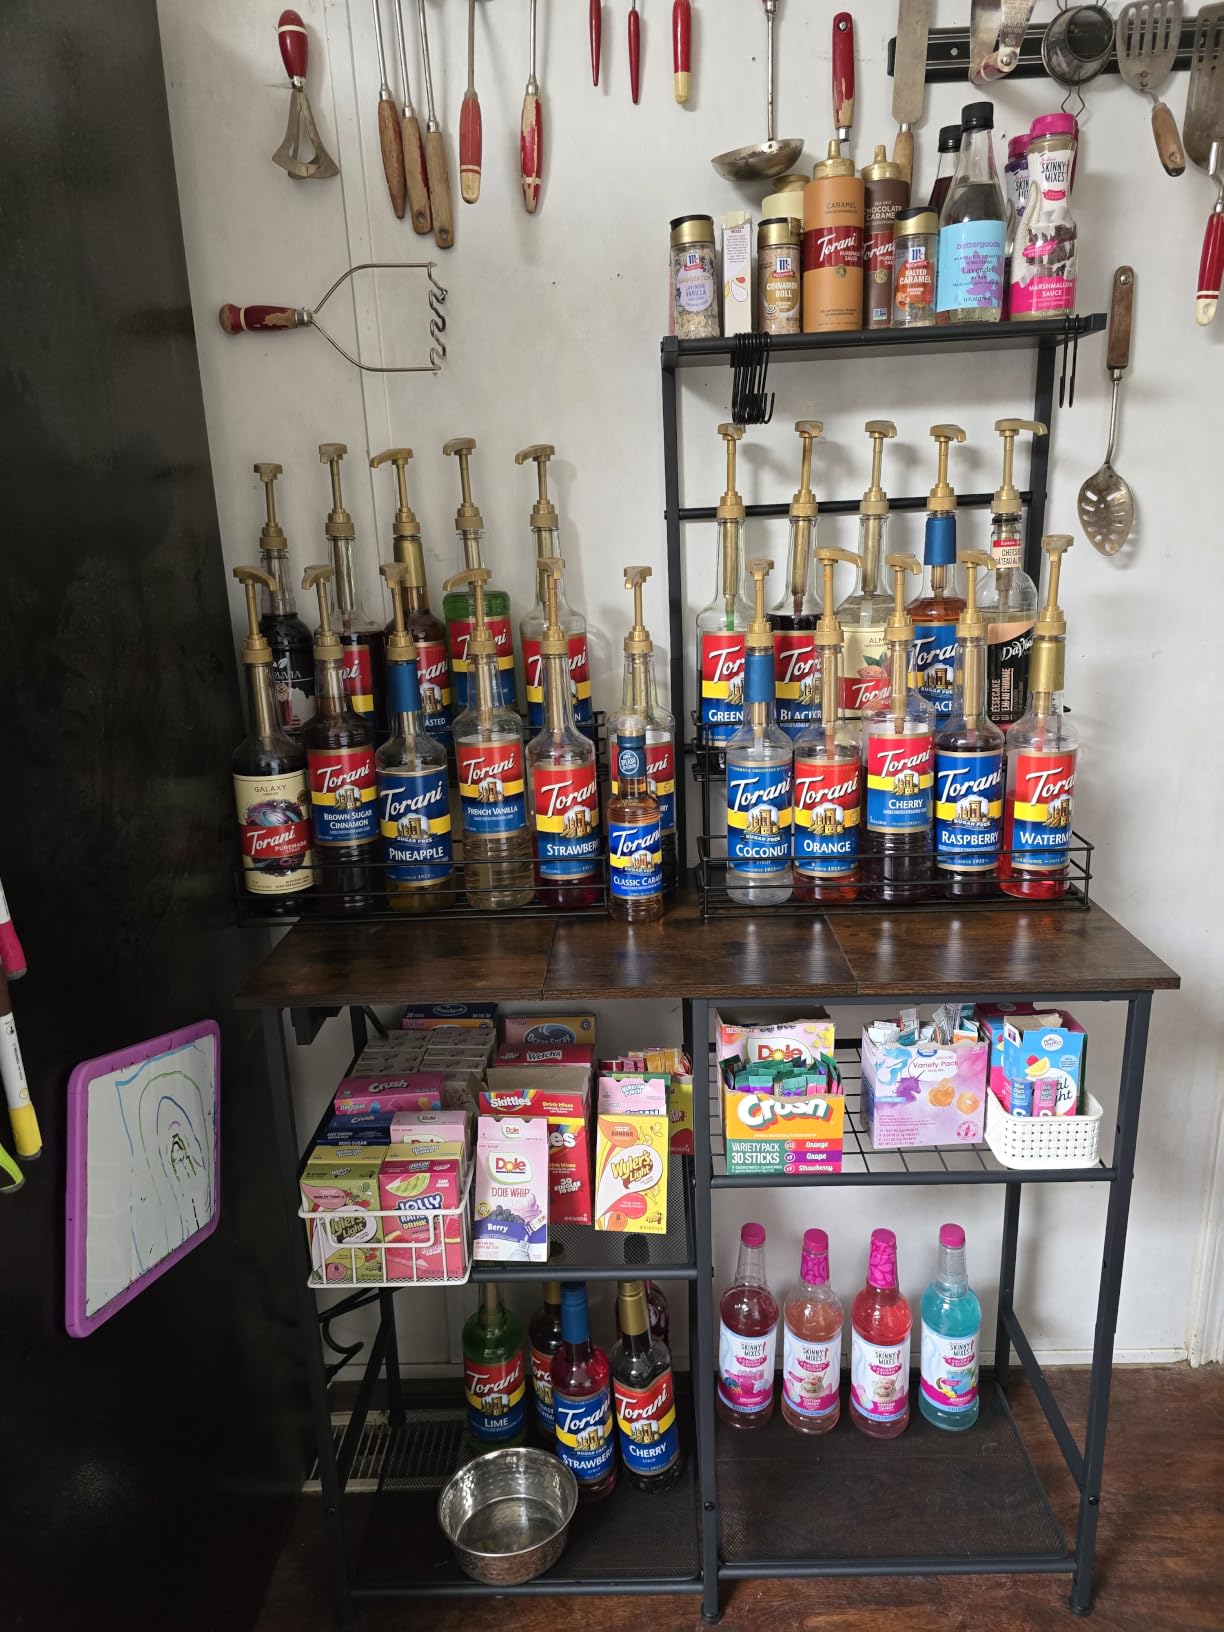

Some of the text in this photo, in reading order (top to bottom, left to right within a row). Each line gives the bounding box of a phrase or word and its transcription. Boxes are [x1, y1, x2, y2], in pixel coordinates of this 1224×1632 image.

[1041, 161, 1065, 173] SKINNY
[1044, 172, 1065, 183] MIXES
[1015, 181, 1029, 191] SKIN
[864, 206, 903, 214] CHOCOLATE
[817, 233, 857, 262] Torani
[900, 276, 932, 284] CARAMEL
[775, 290, 793, 298] ROLL
[424, 717, 446, 727] ASTED
[878, 747, 931, 778] Torani
[463, 753, 515, 786] Torani
[317, 760, 370, 795] Torani
[254, 784, 288, 793] GALAXY
[796, 772, 859, 811] Torani
[1026, 767, 1076, 806] Tora
[730, 772, 792, 813] Torani
[380, 781, 443, 822] Torani
[889, 799, 924, 809] CHERRY
[324, 810, 373, 822] BROWN SUGAR
[467, 806, 518, 816] FRENCH VANILLA
[330, 819, 369, 829] CINNAMON
[247, 826, 296, 856] Torani
[941, 830, 998, 845] RASPBERRY
[736, 844, 788, 857] COCONUT
[804, 840, 851, 853] ORANGE
[389, 847, 444, 861] PINEAPPLE
[613, 876, 641, 887] CLASSIC
[757, 1044, 803, 1061] Dole
[912, 1059, 959, 1069] Variety Pack
[368, 1080, 409, 1093] Crush
[490, 1096, 532, 1107] Skittles
[731, 1142, 780, 1151] VARIETY PACK
[806, 1141, 829, 1149] Orange
[731, 1153, 780, 1164] 30 STICKS
[806, 1153, 827, 1161] Grape
[495, 1157, 527, 1171] Dole
[799, 1164, 834, 1172] Strawberry
[630, 1167, 651, 1182] Light
[491, 1187, 530, 1198] DOLE WHIP
[398, 1195, 441, 1210] JOLLY
[402, 1220, 428, 1230] DRINK
[487, 1223, 509, 1232] Berry
[342, 1224, 365, 1238] Light
[741, 1343, 762, 1351] SKINNY
[950, 1343, 970, 1351] SKINNY
[875, 1351, 896, 1359] SKINNY
[467, 1361, 521, 1395] Torani
[615, 1383, 668, 1420] Torani
[484, 1417, 509, 1428] LIME
[629, 1442, 668, 1457] CHERRY
